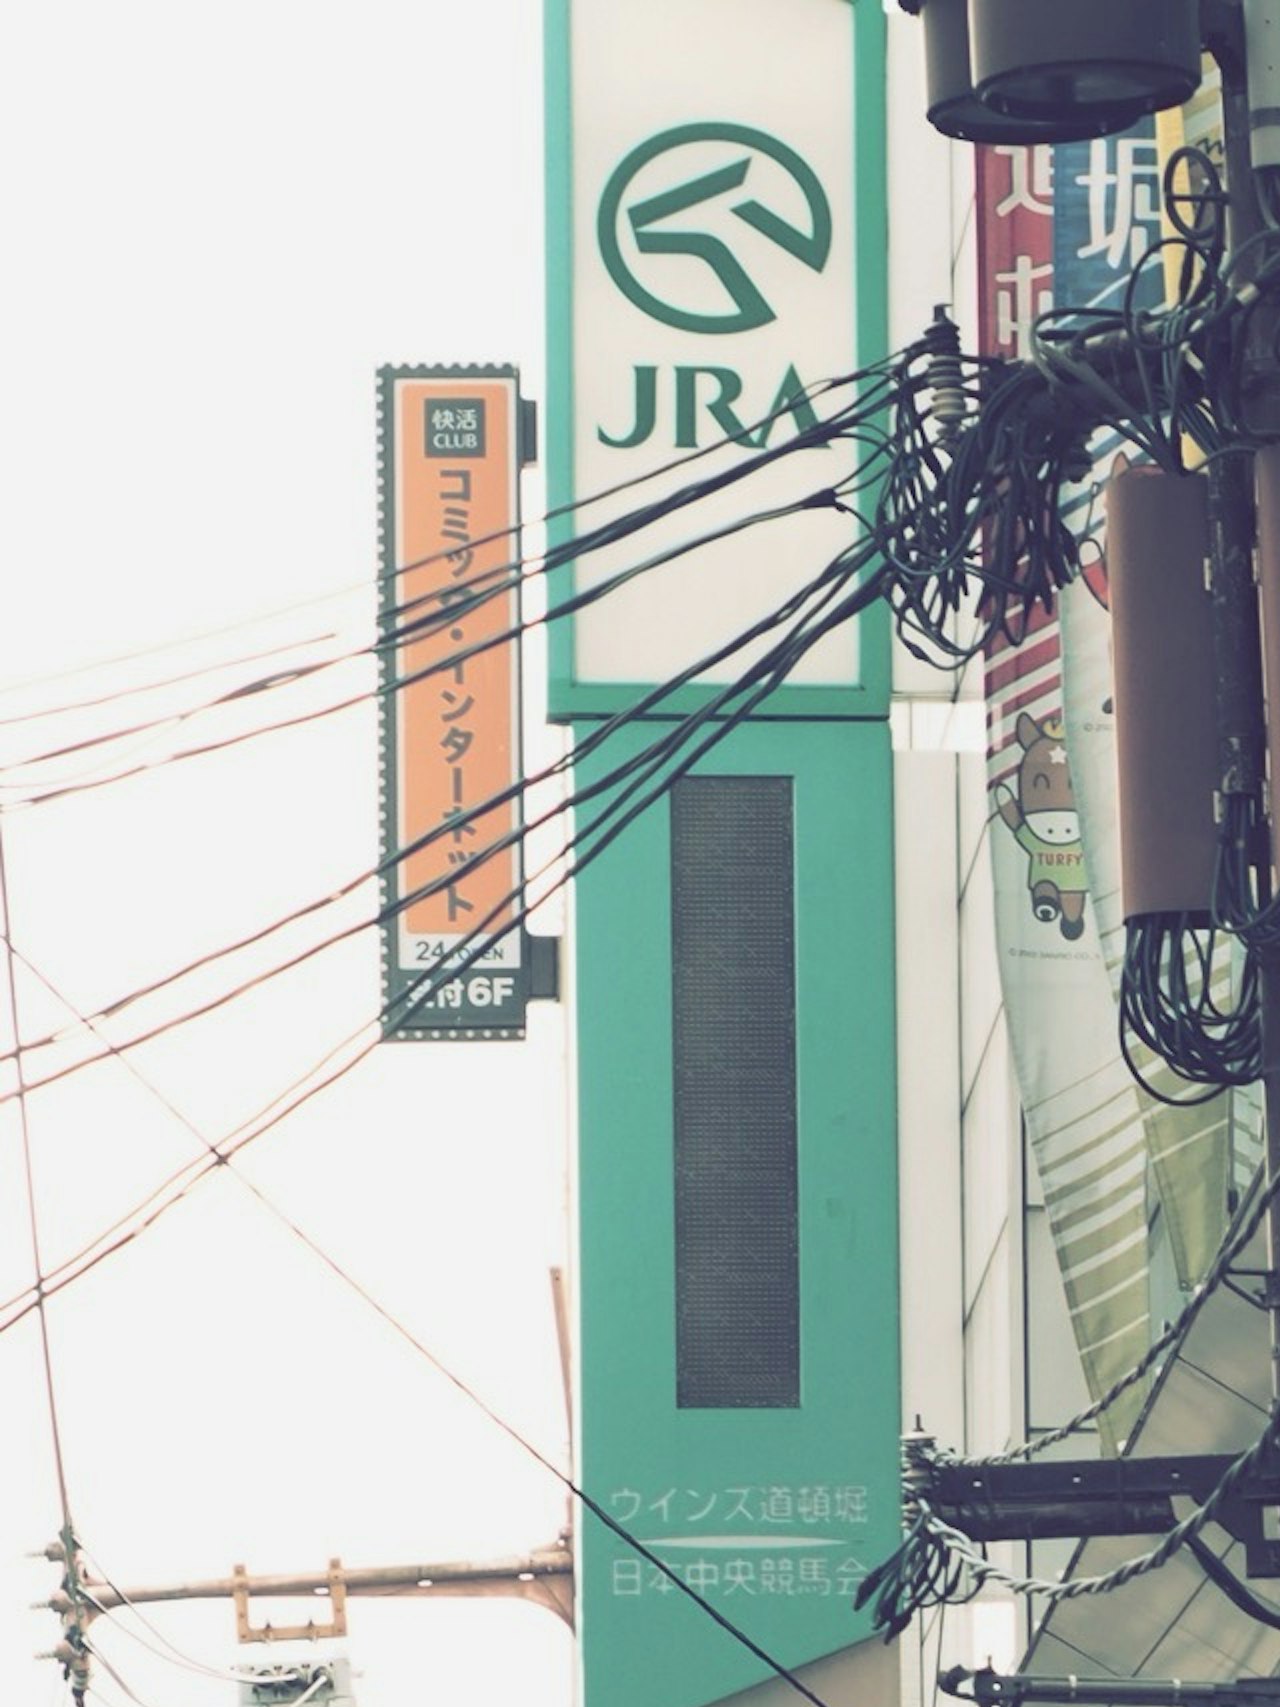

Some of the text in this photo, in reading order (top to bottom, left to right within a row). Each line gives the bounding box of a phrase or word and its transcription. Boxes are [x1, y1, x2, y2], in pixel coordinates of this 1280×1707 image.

[432, 408, 477, 430] 快活
[598, 362, 831, 450] JRA
[433, 433, 478, 448] CLUB
[438, 469, 479, 922] コミッ・ンターネト
[416, 941, 504, 961] 24 OEN
[610, 1485, 868, 1523] ウインズ道頓堀
[612, 1557, 869, 1596] 日本中央競馬会
